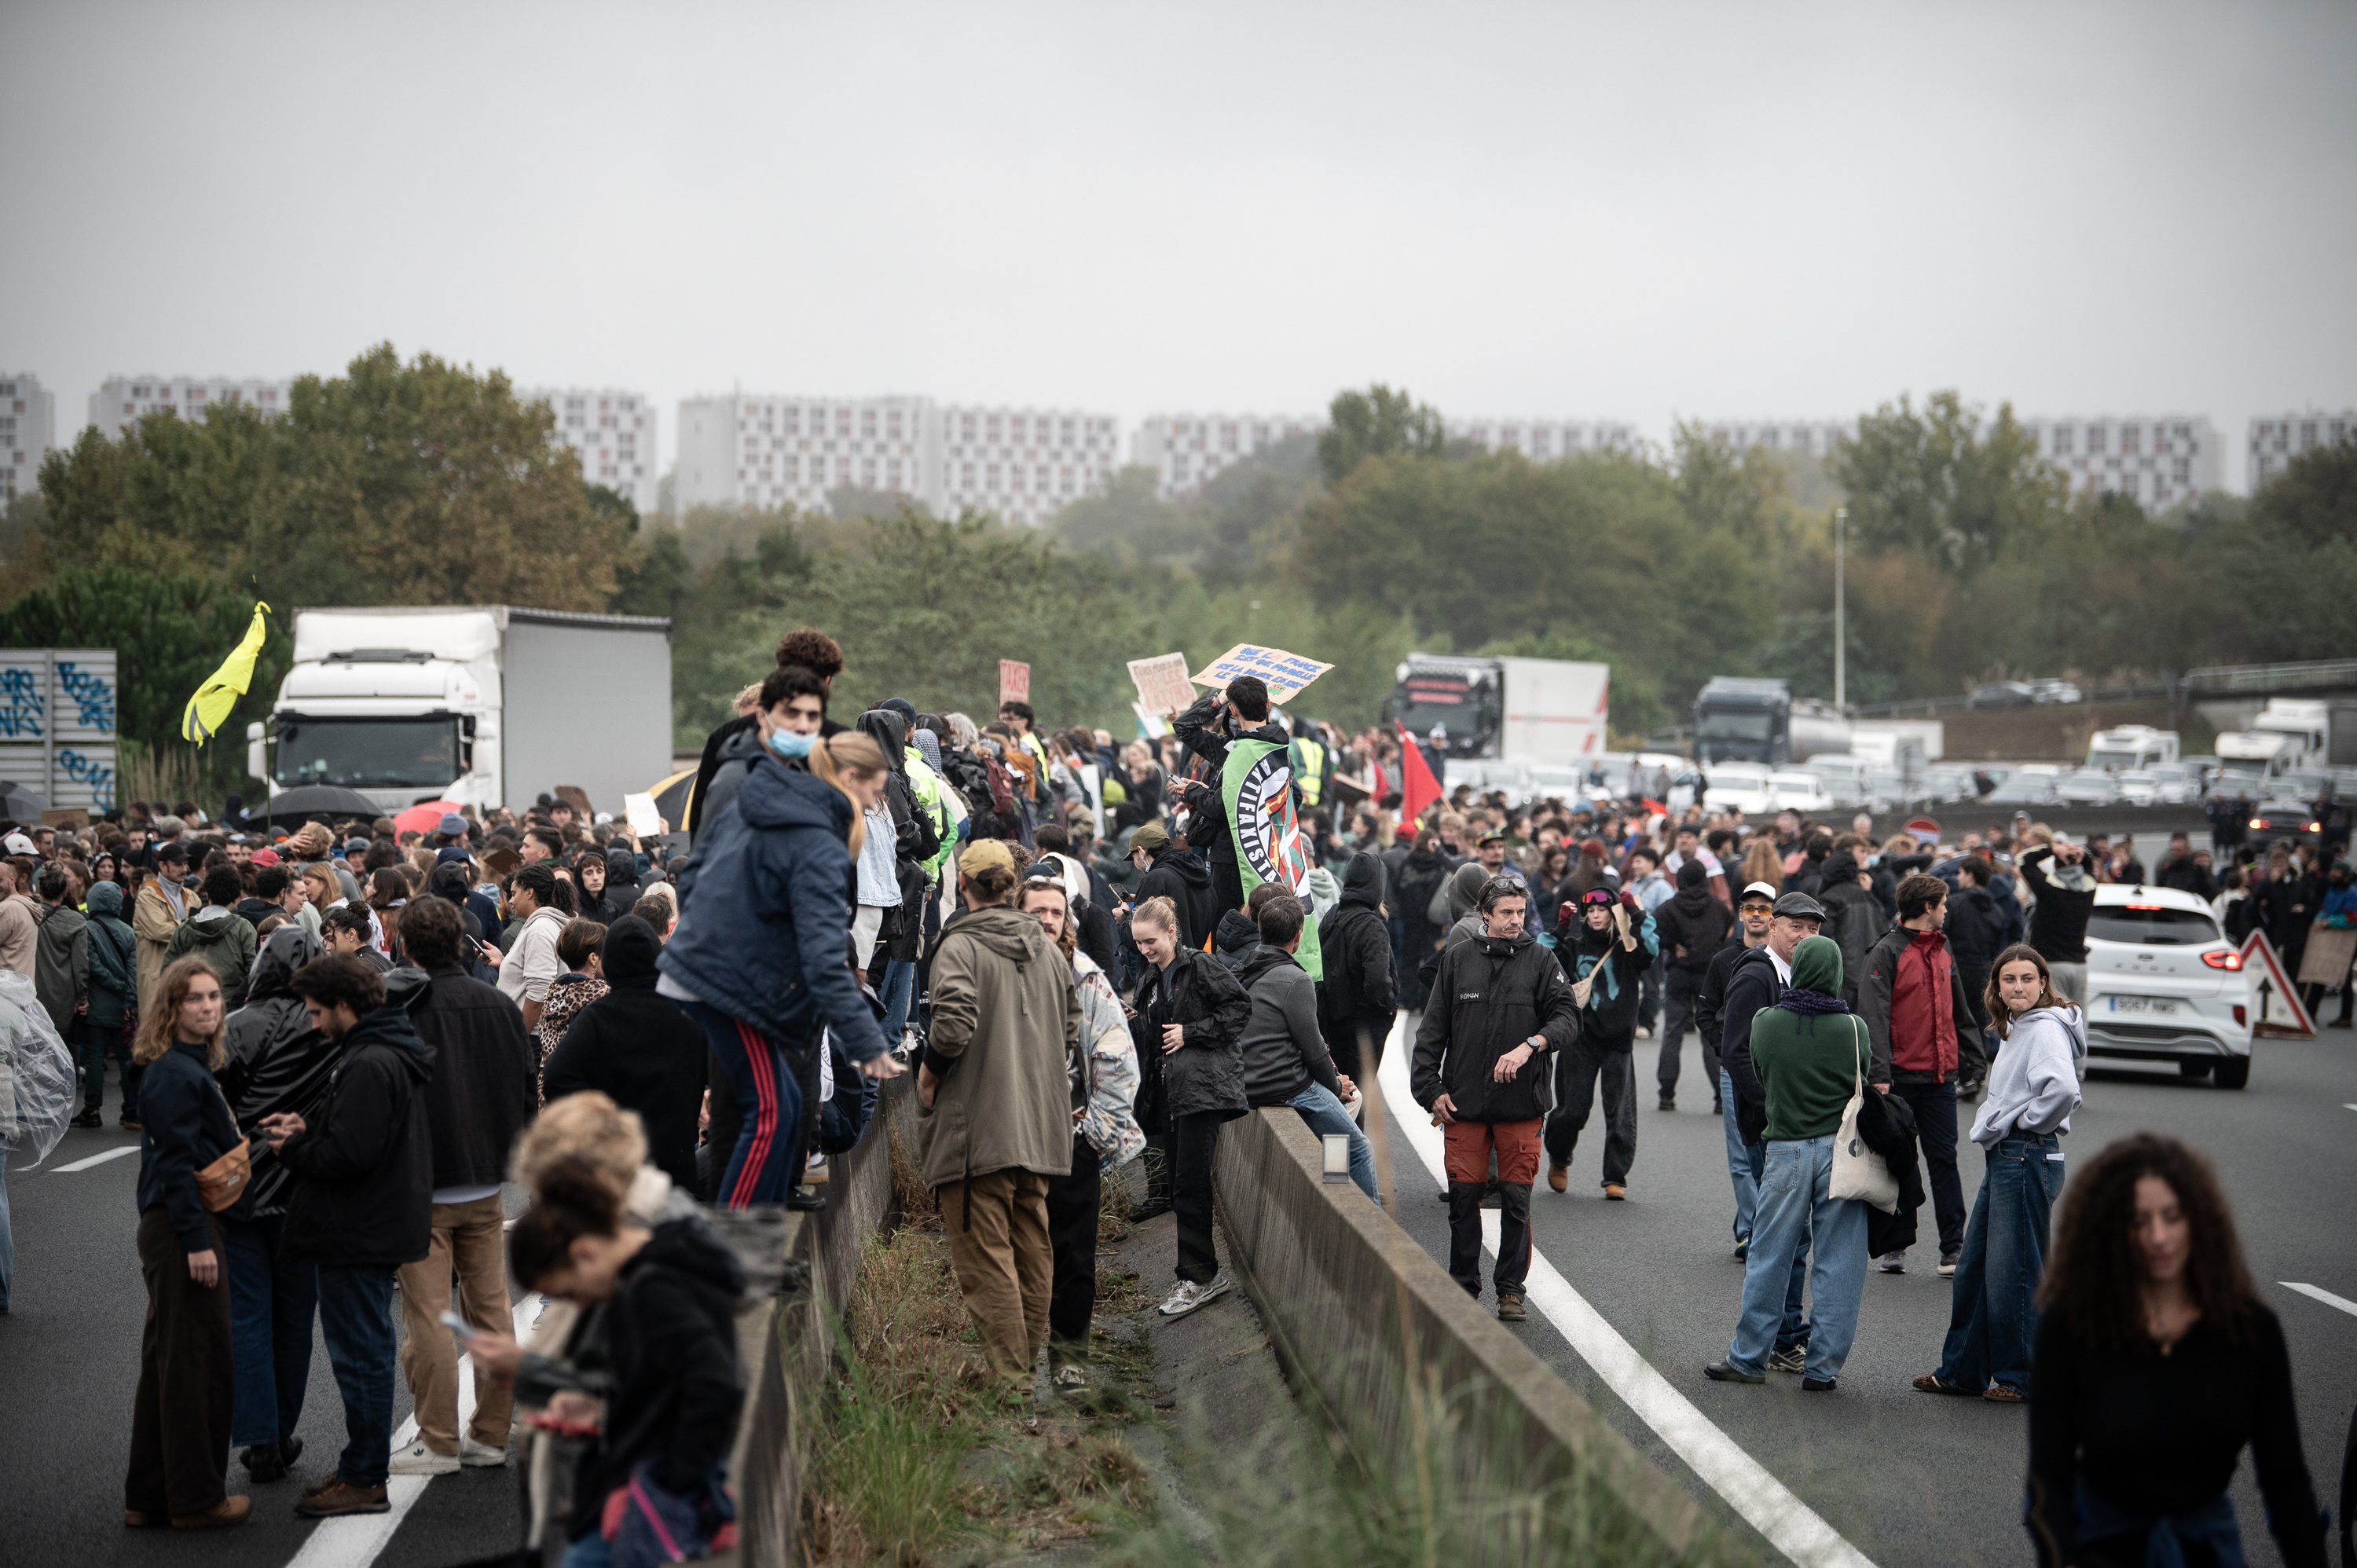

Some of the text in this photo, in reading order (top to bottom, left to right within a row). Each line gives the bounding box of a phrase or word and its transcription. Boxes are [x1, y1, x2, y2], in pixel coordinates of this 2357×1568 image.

[1270, 664, 1316, 680] POUBELLE
[1282, 658, 1322, 672] FRANCE
[1162, 669, 1182, 685] LES
